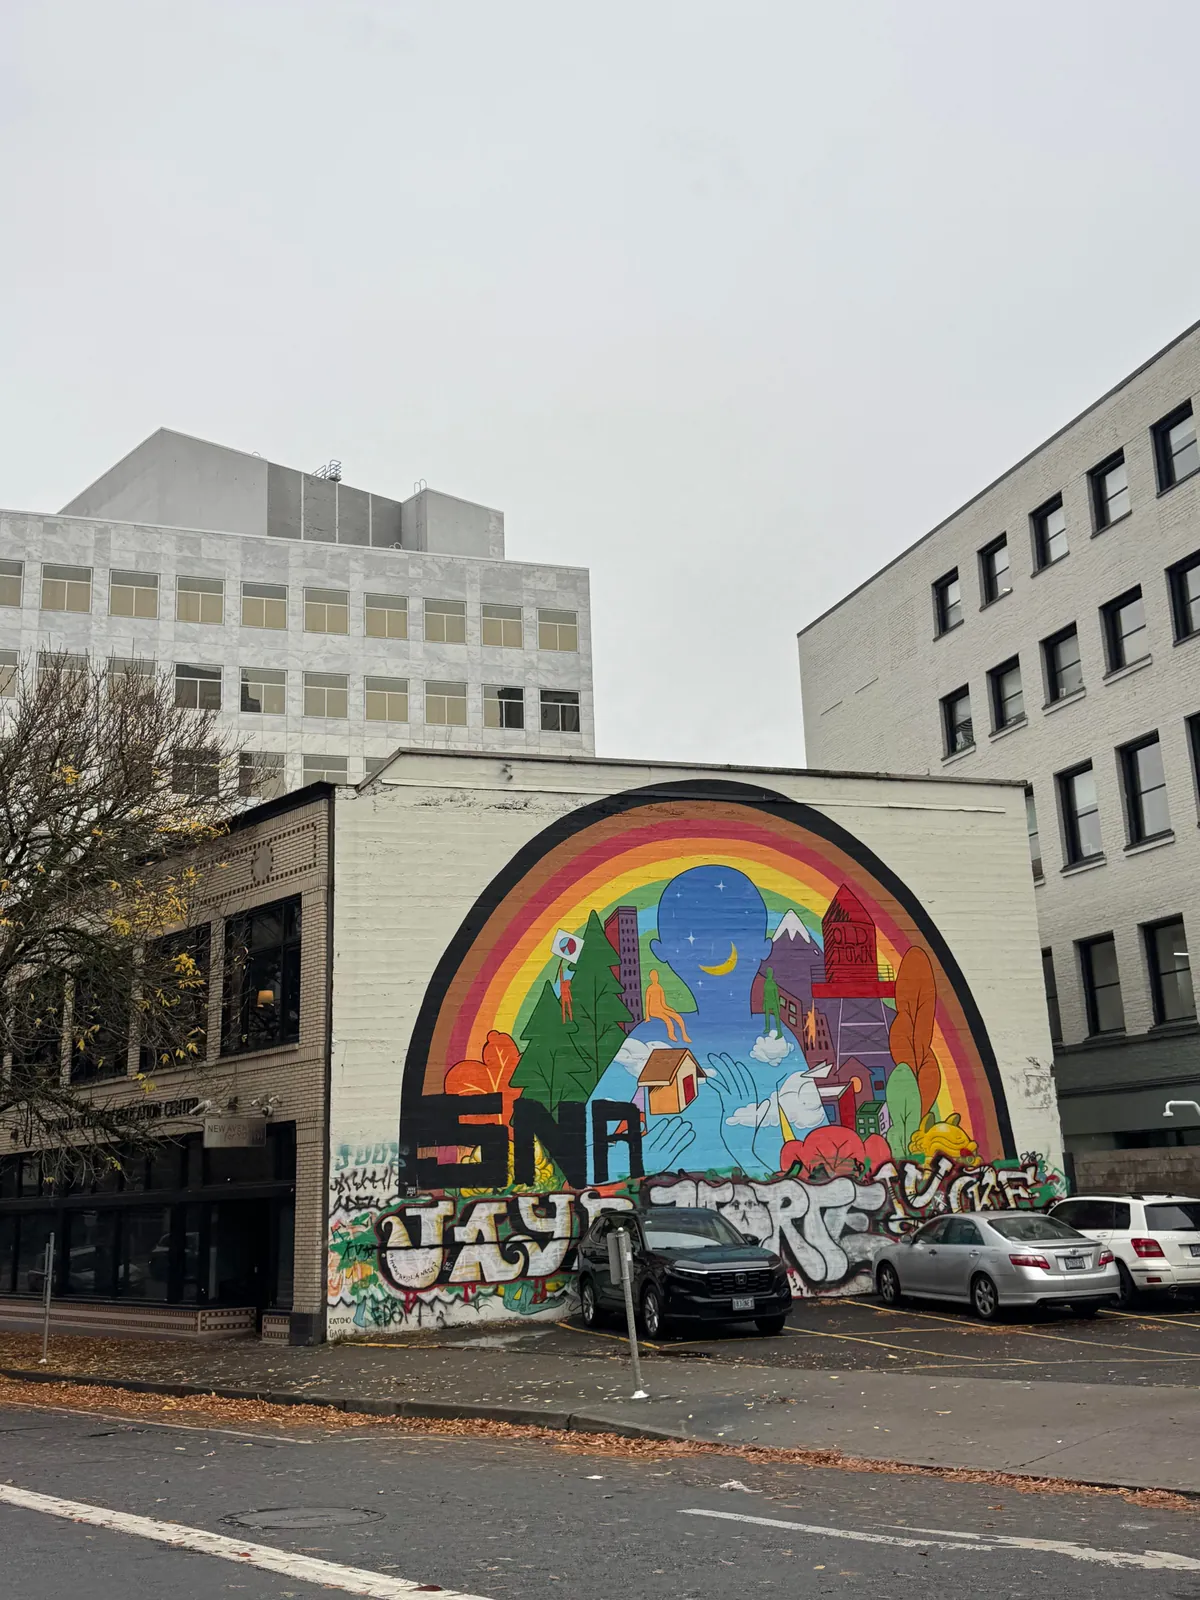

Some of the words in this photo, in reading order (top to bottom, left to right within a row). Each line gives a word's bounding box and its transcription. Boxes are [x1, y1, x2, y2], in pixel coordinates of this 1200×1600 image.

[832, 926, 868, 946] OLD
[833, 945, 874, 963] TOWN
[207, 1124, 225, 1133] NEW
